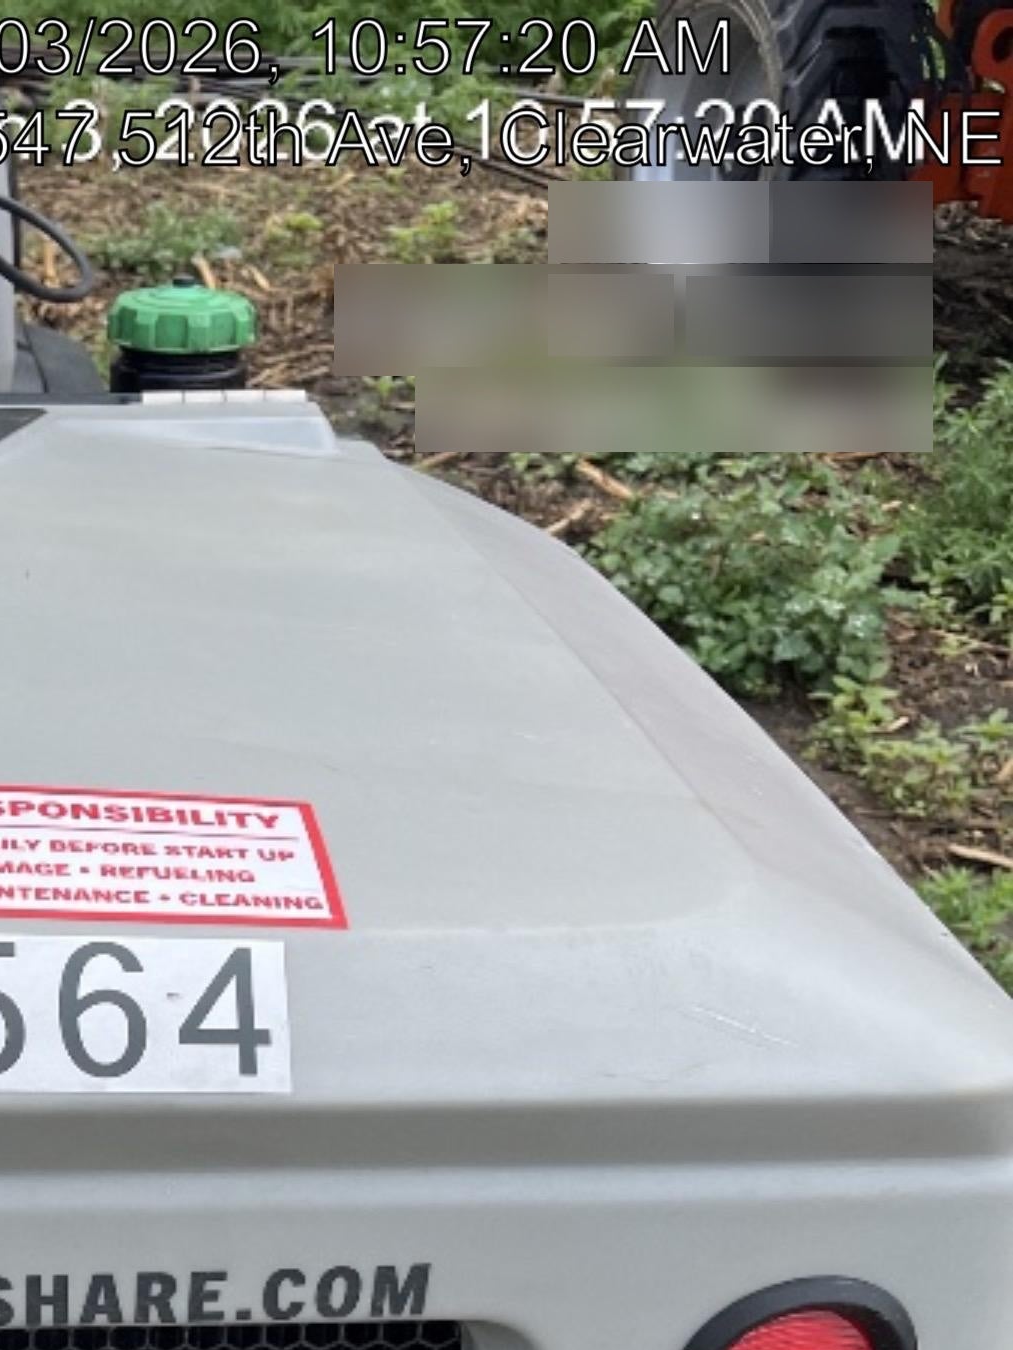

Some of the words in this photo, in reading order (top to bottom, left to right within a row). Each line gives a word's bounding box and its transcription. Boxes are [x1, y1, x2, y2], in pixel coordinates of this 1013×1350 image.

[49, 839, 158, 856] BEFORE
[163, 845, 249, 860] START
[256, 847, 295, 862] UP
[100, 864, 256, 883] REFUELING
[178, 892, 325, 911] CLEANING
